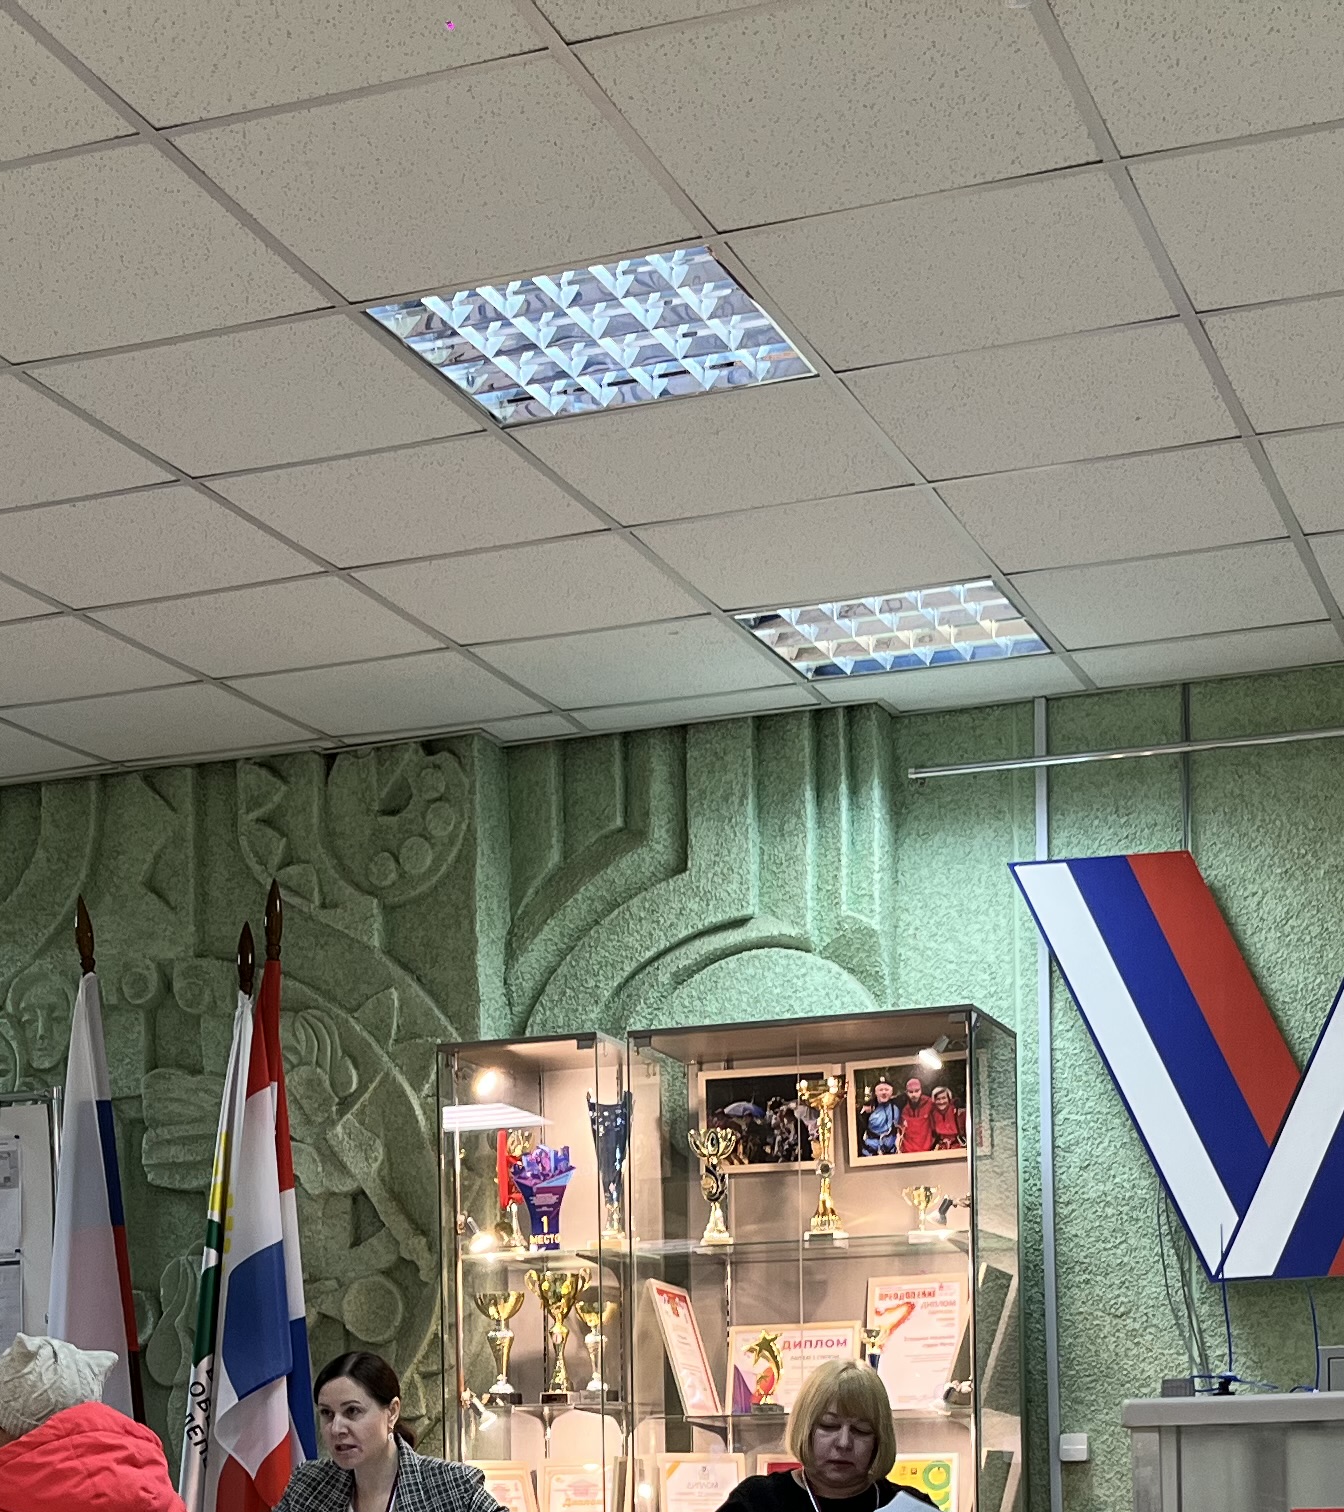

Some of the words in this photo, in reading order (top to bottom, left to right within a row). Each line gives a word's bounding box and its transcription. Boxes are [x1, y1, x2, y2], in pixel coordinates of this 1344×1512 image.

[541, 1215, 549, 1233] 1
[529, 1234, 561, 1245] МЕСТО
[782, 1338, 847, 1351] ДИПЛОМ
